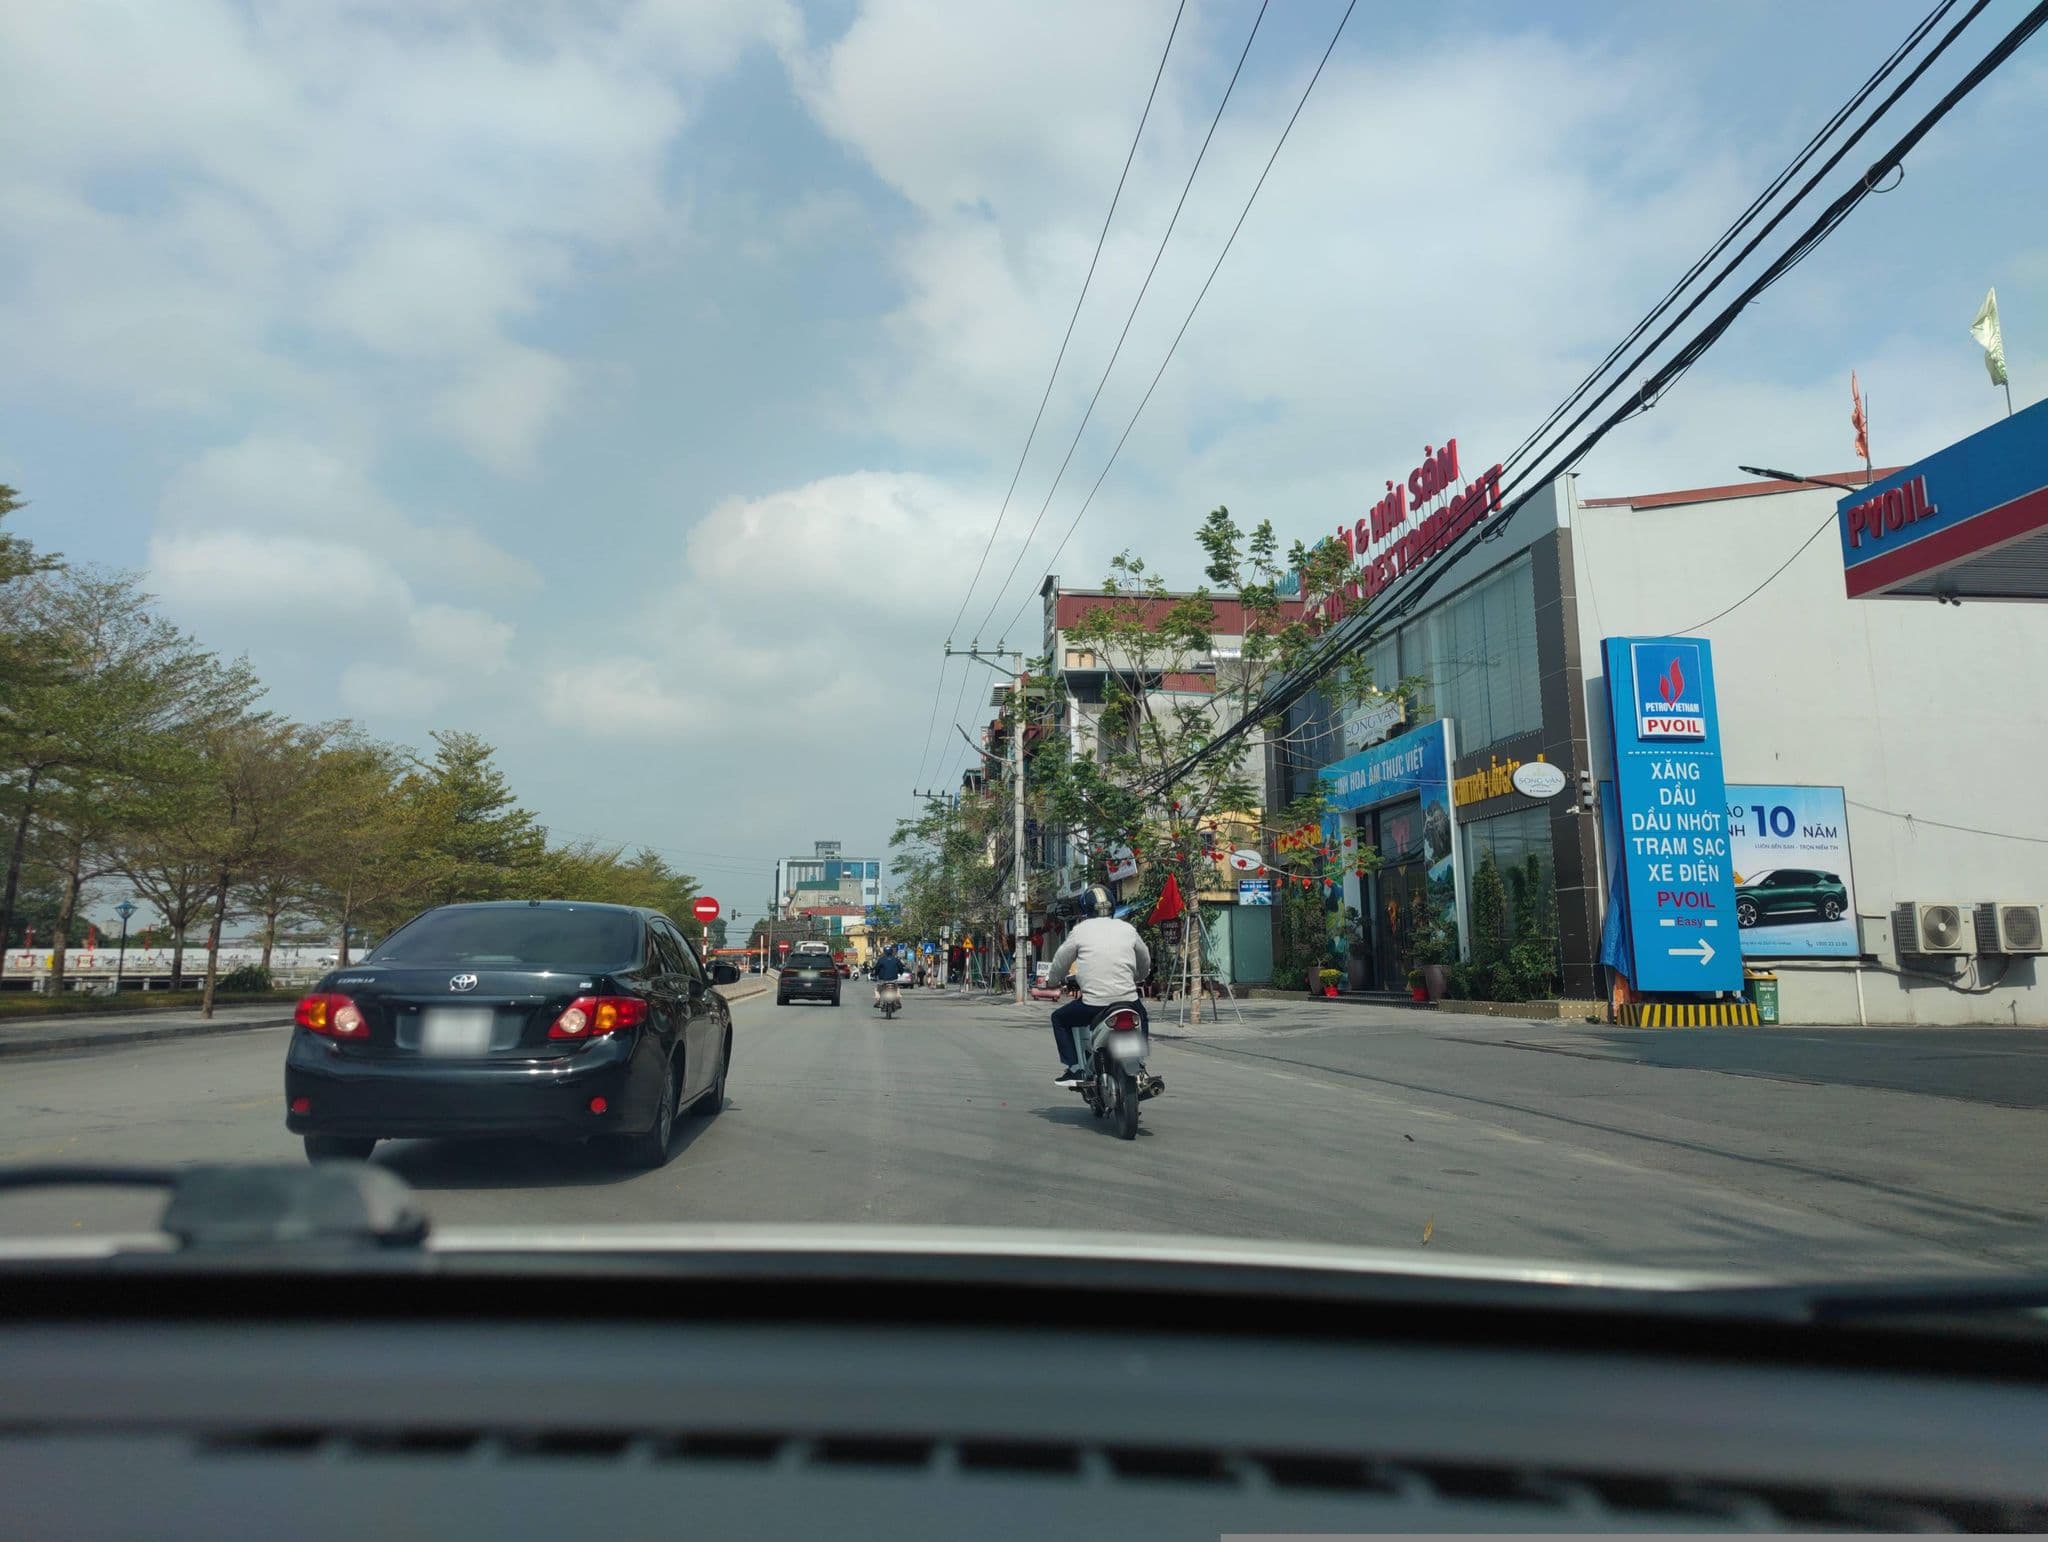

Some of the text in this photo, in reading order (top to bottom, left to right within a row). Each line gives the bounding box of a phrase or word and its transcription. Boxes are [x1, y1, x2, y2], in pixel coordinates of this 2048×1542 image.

[1370, 480, 1406, 544] HẢI
[1408, 438, 1458, 511] SẢN
[1847, 475, 1938, 548] PVOIL
[1645, 702, 1699, 712] PETROVIETNAM
[1647, 719, 1701, 733] PVOIL
[1405, 745, 1424, 775] VIỆT
[1651, 758, 1700, 780] XĂNG
[1659, 782, 1696, 806] DẦU
[1632, 806, 1721, 831] DẦU NHỚT
[1751, 805, 1796, 838] 10
[1803, 823, 1838, 838] NĂM
[1632, 837, 1725, 860] TRẠM SẠC
[1648, 859, 1719, 886] XE ĐIỆN
[1657, 891, 1716, 908] PVOIL
[1677, 916, 1703, 928] Easy
